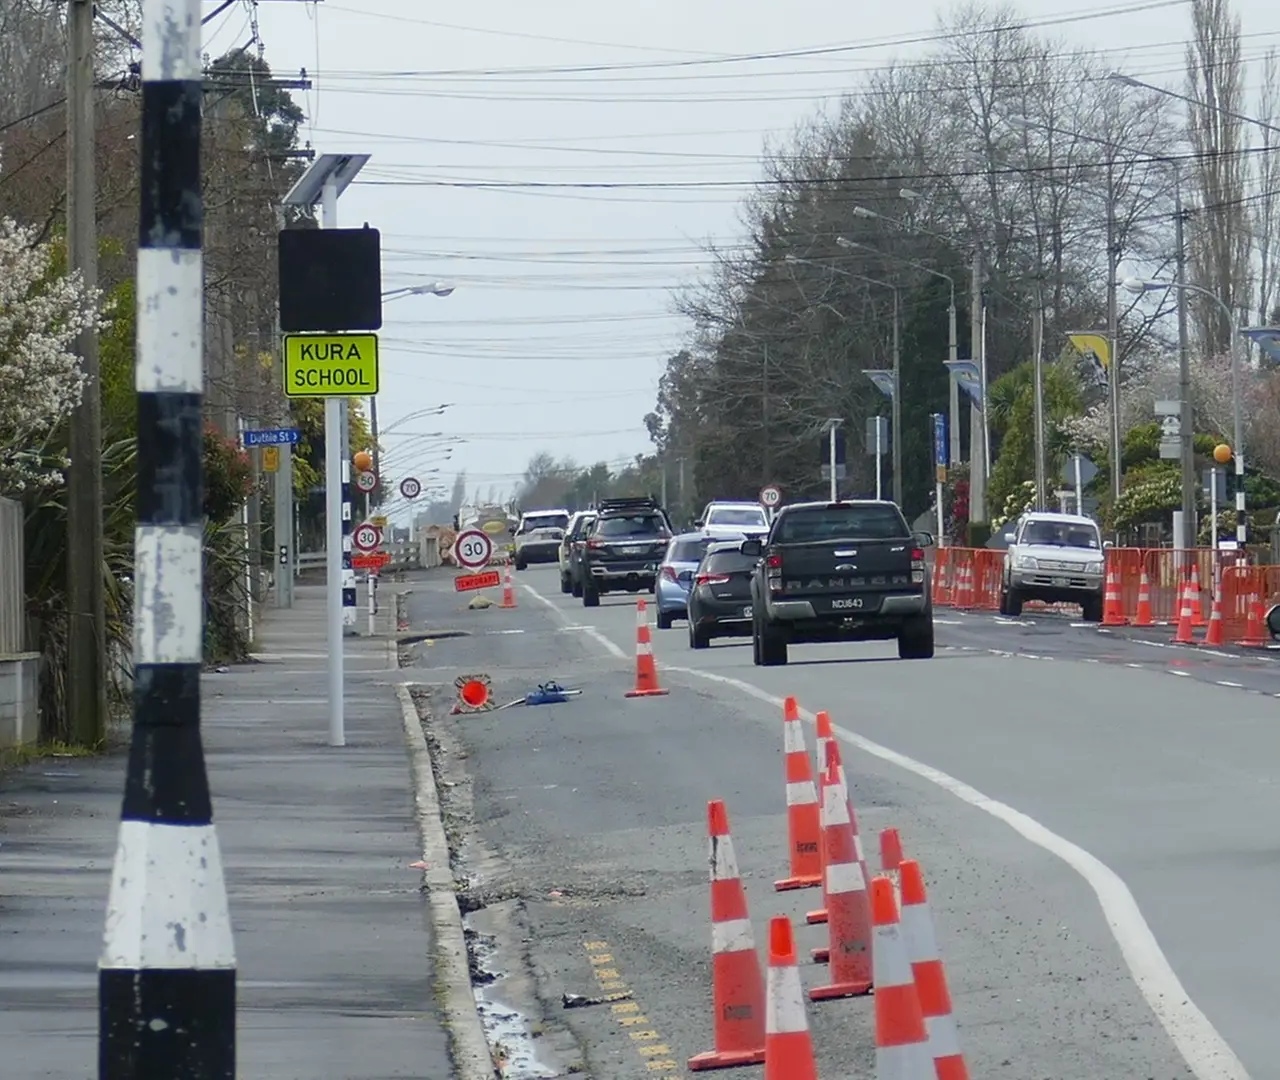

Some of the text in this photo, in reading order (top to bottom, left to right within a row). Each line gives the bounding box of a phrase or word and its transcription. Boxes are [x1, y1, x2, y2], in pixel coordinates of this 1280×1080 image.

[301, 343, 361, 360] KURA
[294, 368, 369, 386] SCHOOL
[279, 431, 290, 442] St
[361, 476, 374, 486] 50
[405, 483, 417, 492] 70
[764, 491, 777, 501] 70
[360, 532, 374, 543] 30
[464, 541, 483, 557] 30
